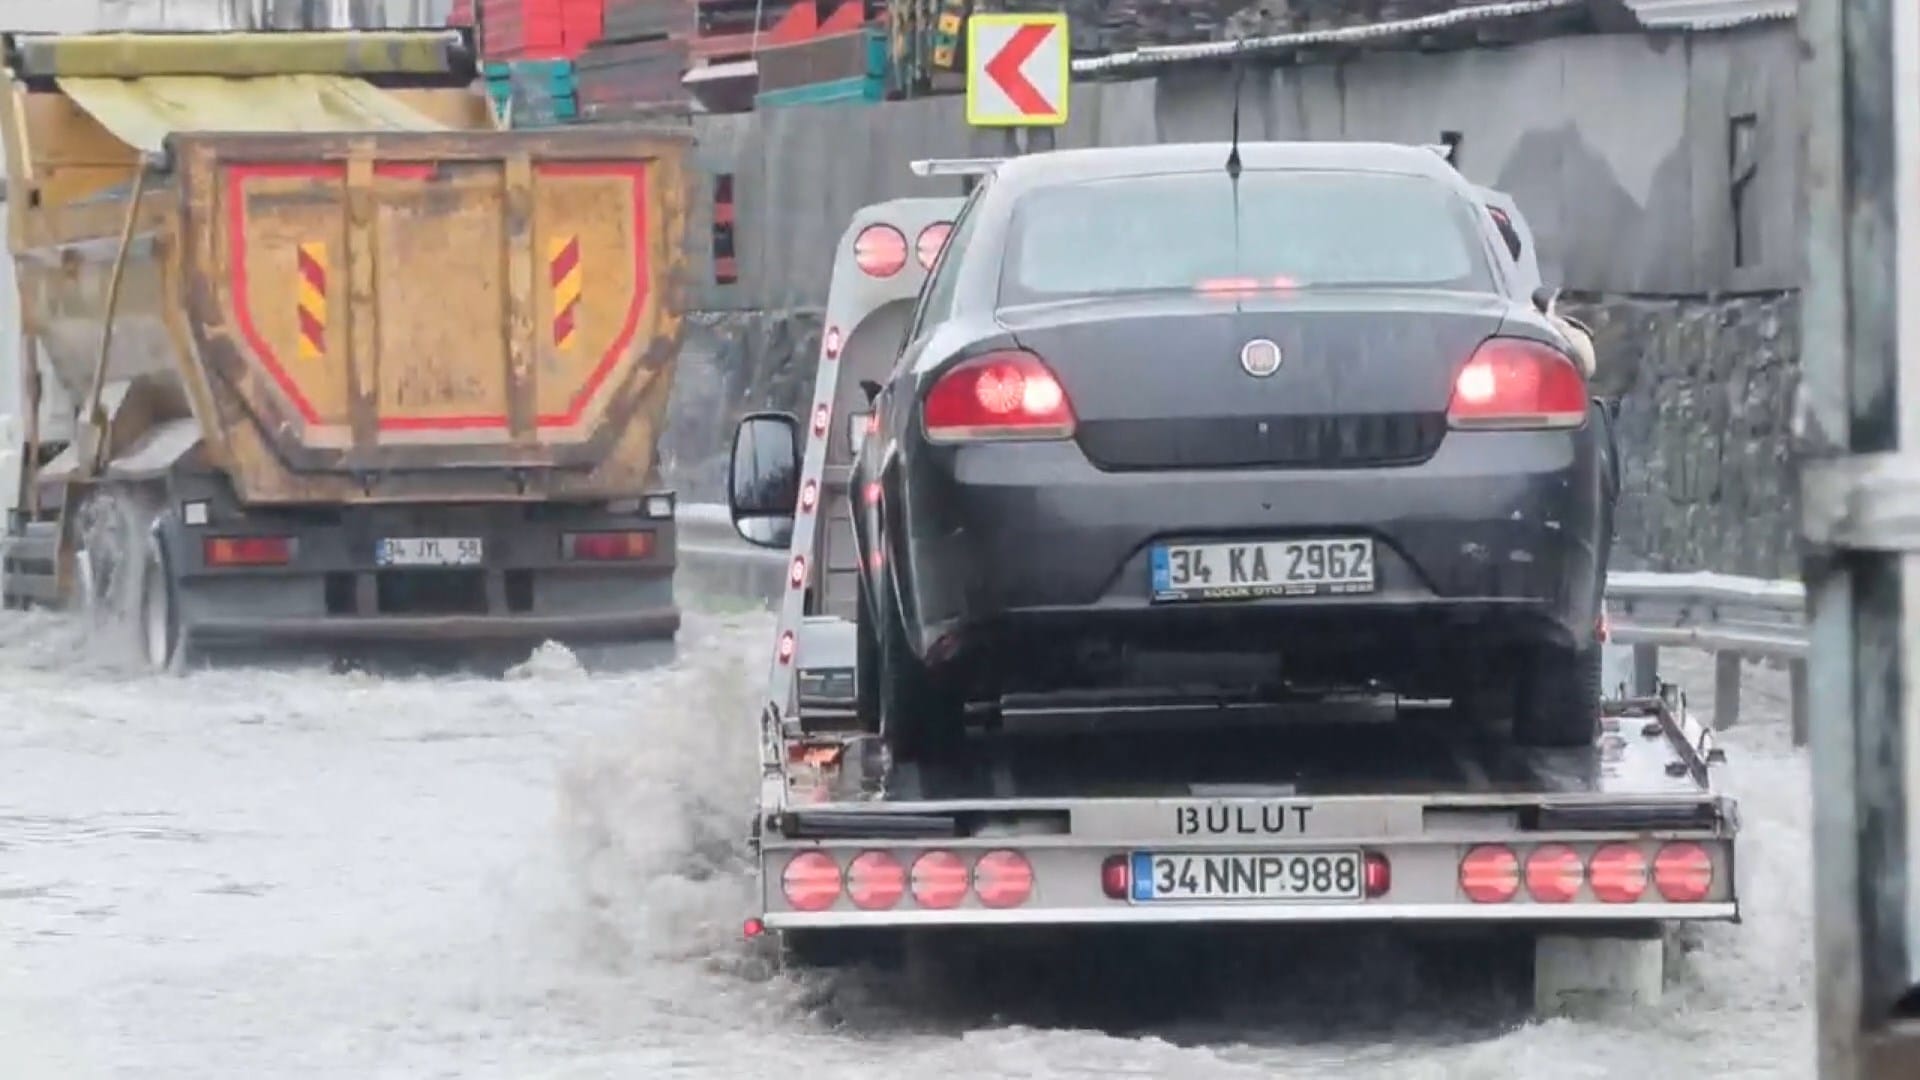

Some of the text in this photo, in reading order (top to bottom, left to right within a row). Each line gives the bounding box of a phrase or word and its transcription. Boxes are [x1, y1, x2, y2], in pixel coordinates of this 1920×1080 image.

[1172, 543, 1368, 583] 34 KA 2962
[1176, 805, 1313, 834] BULUT
